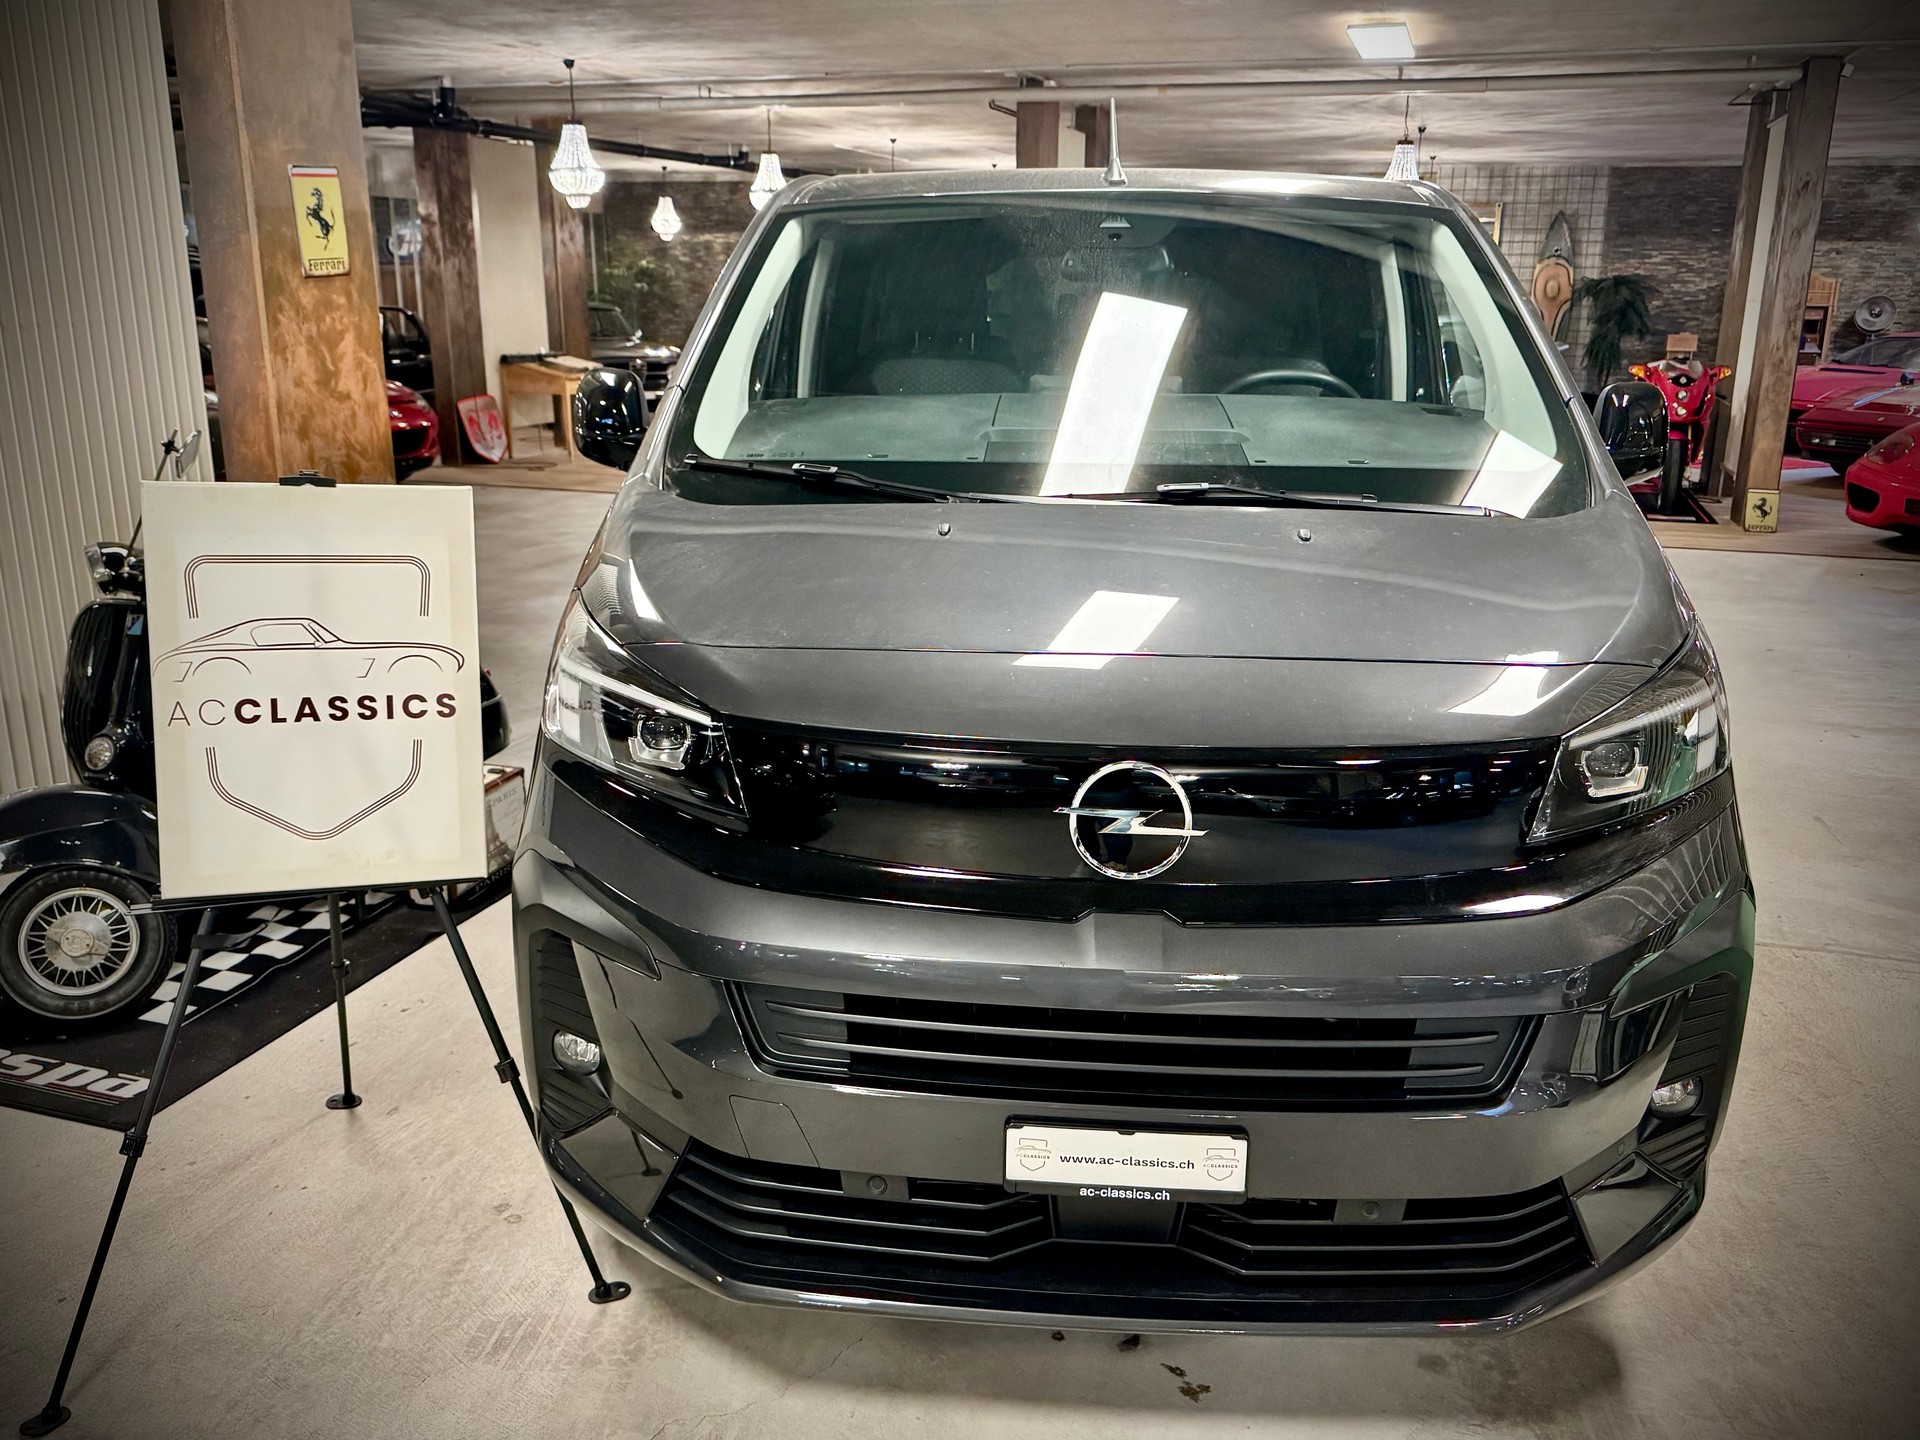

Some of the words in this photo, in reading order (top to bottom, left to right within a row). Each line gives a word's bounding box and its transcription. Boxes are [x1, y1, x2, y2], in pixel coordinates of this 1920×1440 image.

[308, 257, 346, 271] Ferrari
[1060, 1155, 1195, 1170] www.ac-classics.ch
[1079, 1187, 1170, 1201] ac-classics.ch
